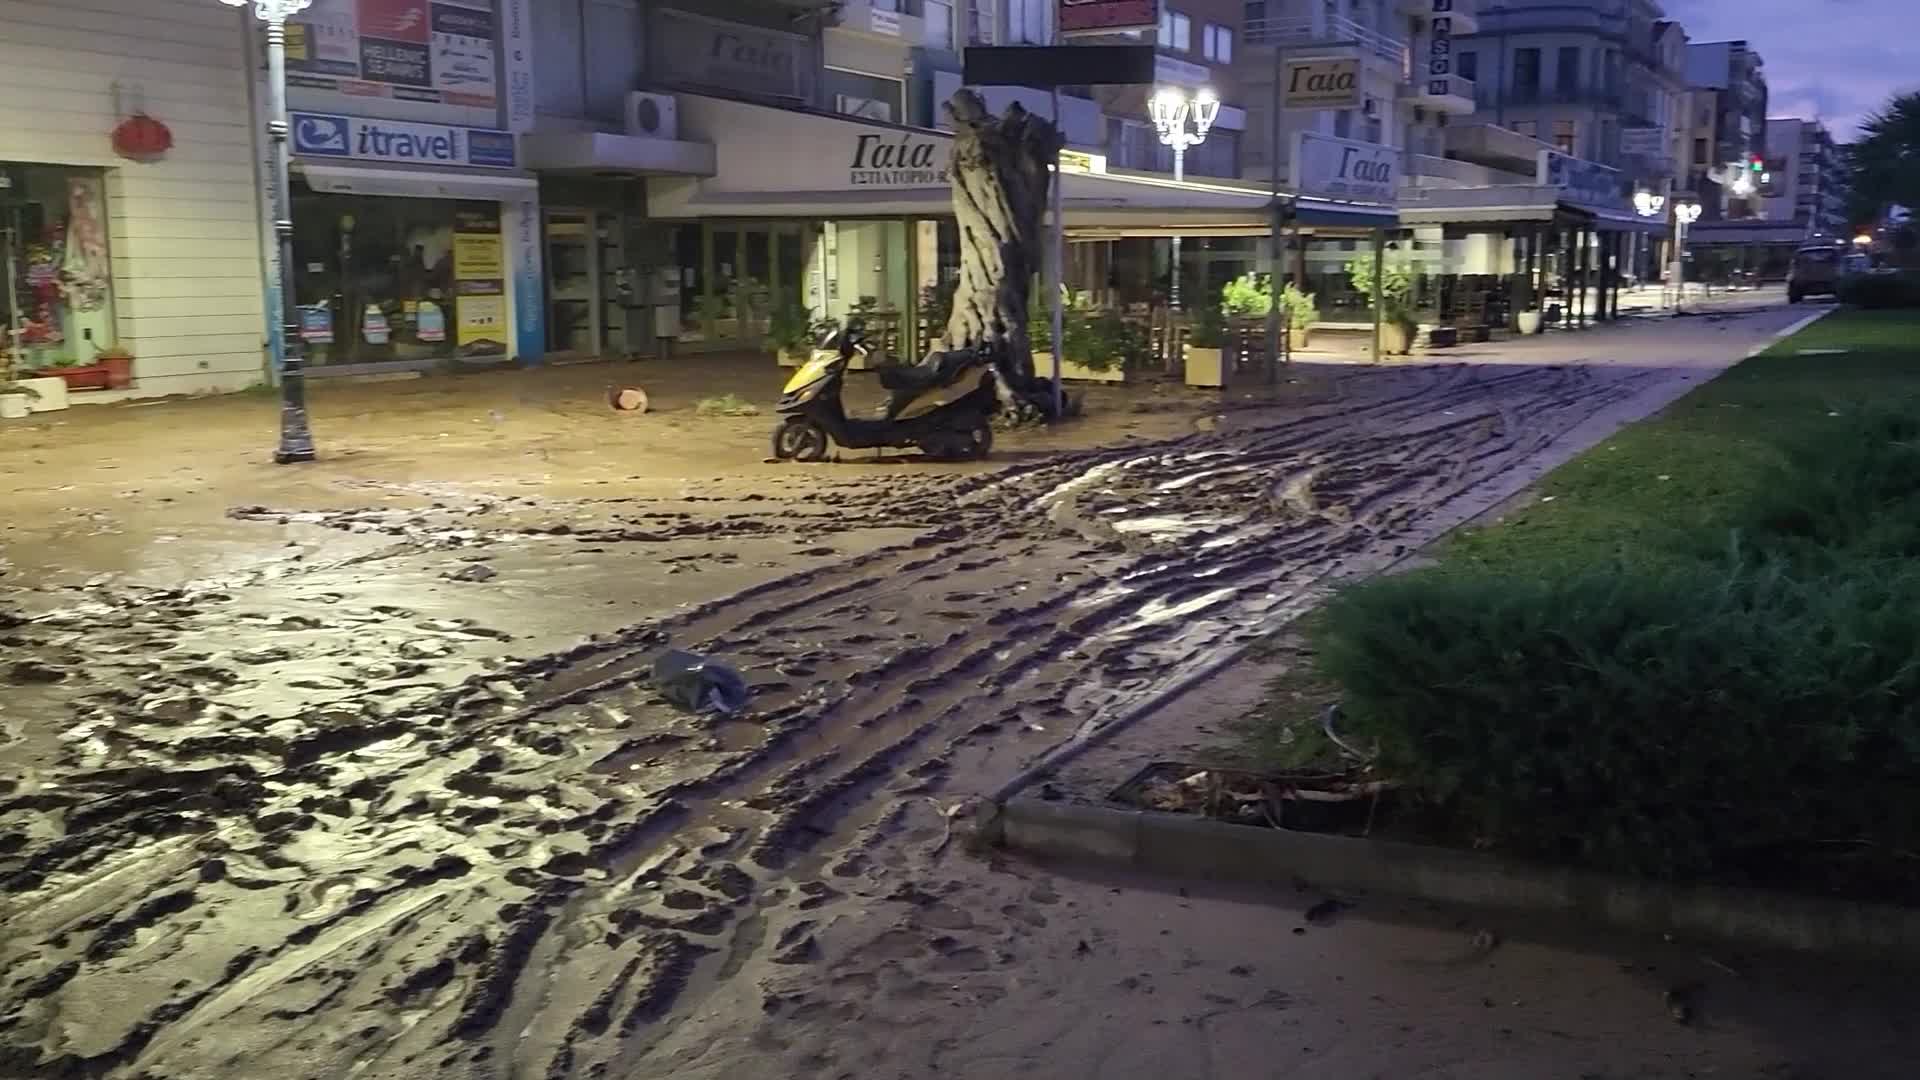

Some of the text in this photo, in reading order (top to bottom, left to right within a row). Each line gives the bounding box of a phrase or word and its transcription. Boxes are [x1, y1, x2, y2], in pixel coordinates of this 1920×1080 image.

[1288, 63, 1356, 93] Γαία
[357, 124, 456, 160] itravel
[850, 134, 935, 169] Γαία
[1337, 147, 1391, 183] Γαία
